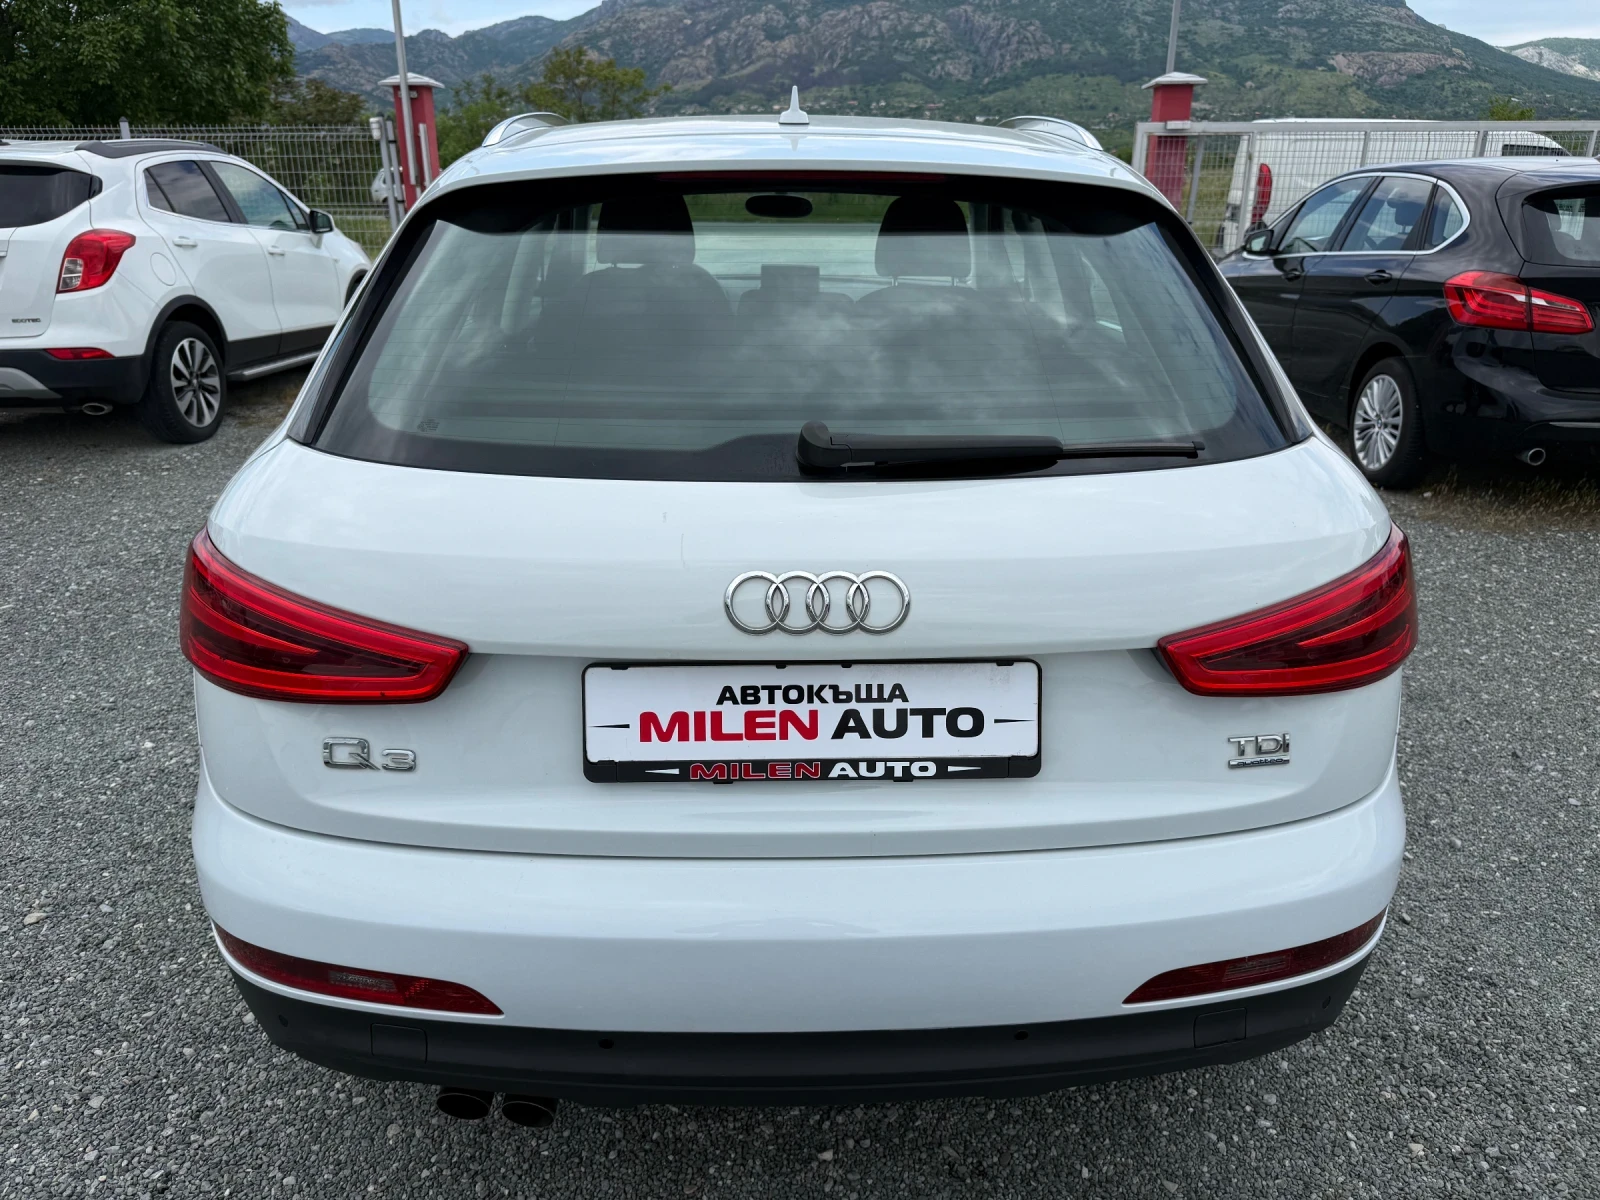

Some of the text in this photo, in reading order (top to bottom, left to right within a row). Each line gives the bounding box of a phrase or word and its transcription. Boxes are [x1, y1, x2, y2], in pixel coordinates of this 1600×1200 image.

[716, 683, 909, 705] АВТОКЪЩА
[639, 707, 985, 742] MILEN AUTO
[690, 761, 937, 780] MILEN AUTO
